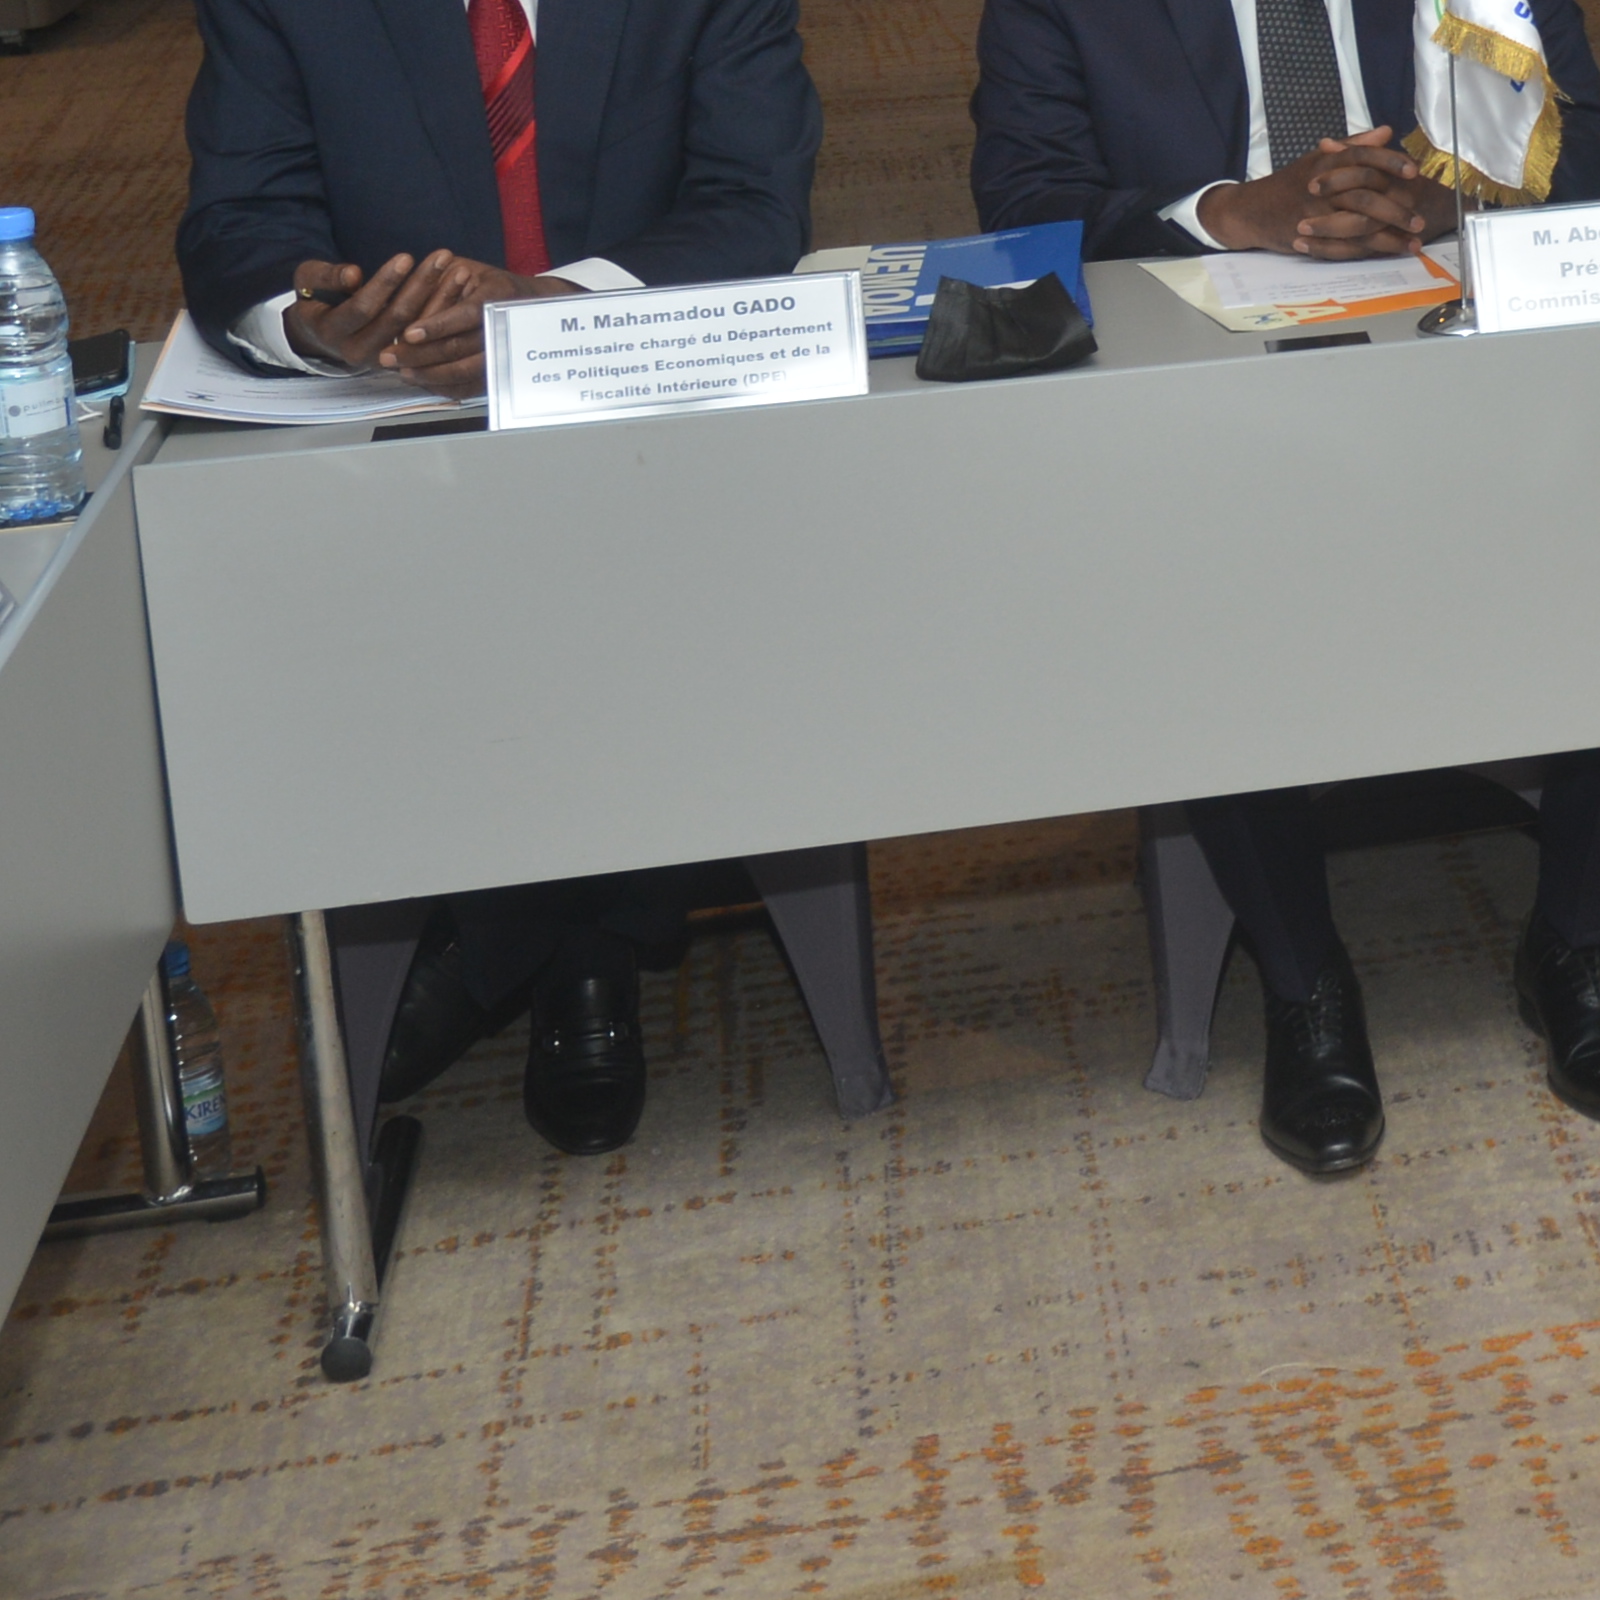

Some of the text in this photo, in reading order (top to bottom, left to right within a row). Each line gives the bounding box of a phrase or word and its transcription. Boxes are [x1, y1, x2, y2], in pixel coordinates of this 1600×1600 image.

[1532, 230, 1560, 247] M.
[863, 245, 928, 317] UEMOA
[560, 296, 797, 333] M. Mahamadou GADO
[526, 319, 834, 362] Commissaire chargé du Département
[531, 342, 831, 384] des Politiques Economiques et de la
[580, 369, 788, 403] Fiscalité Intérieure (DPE)
